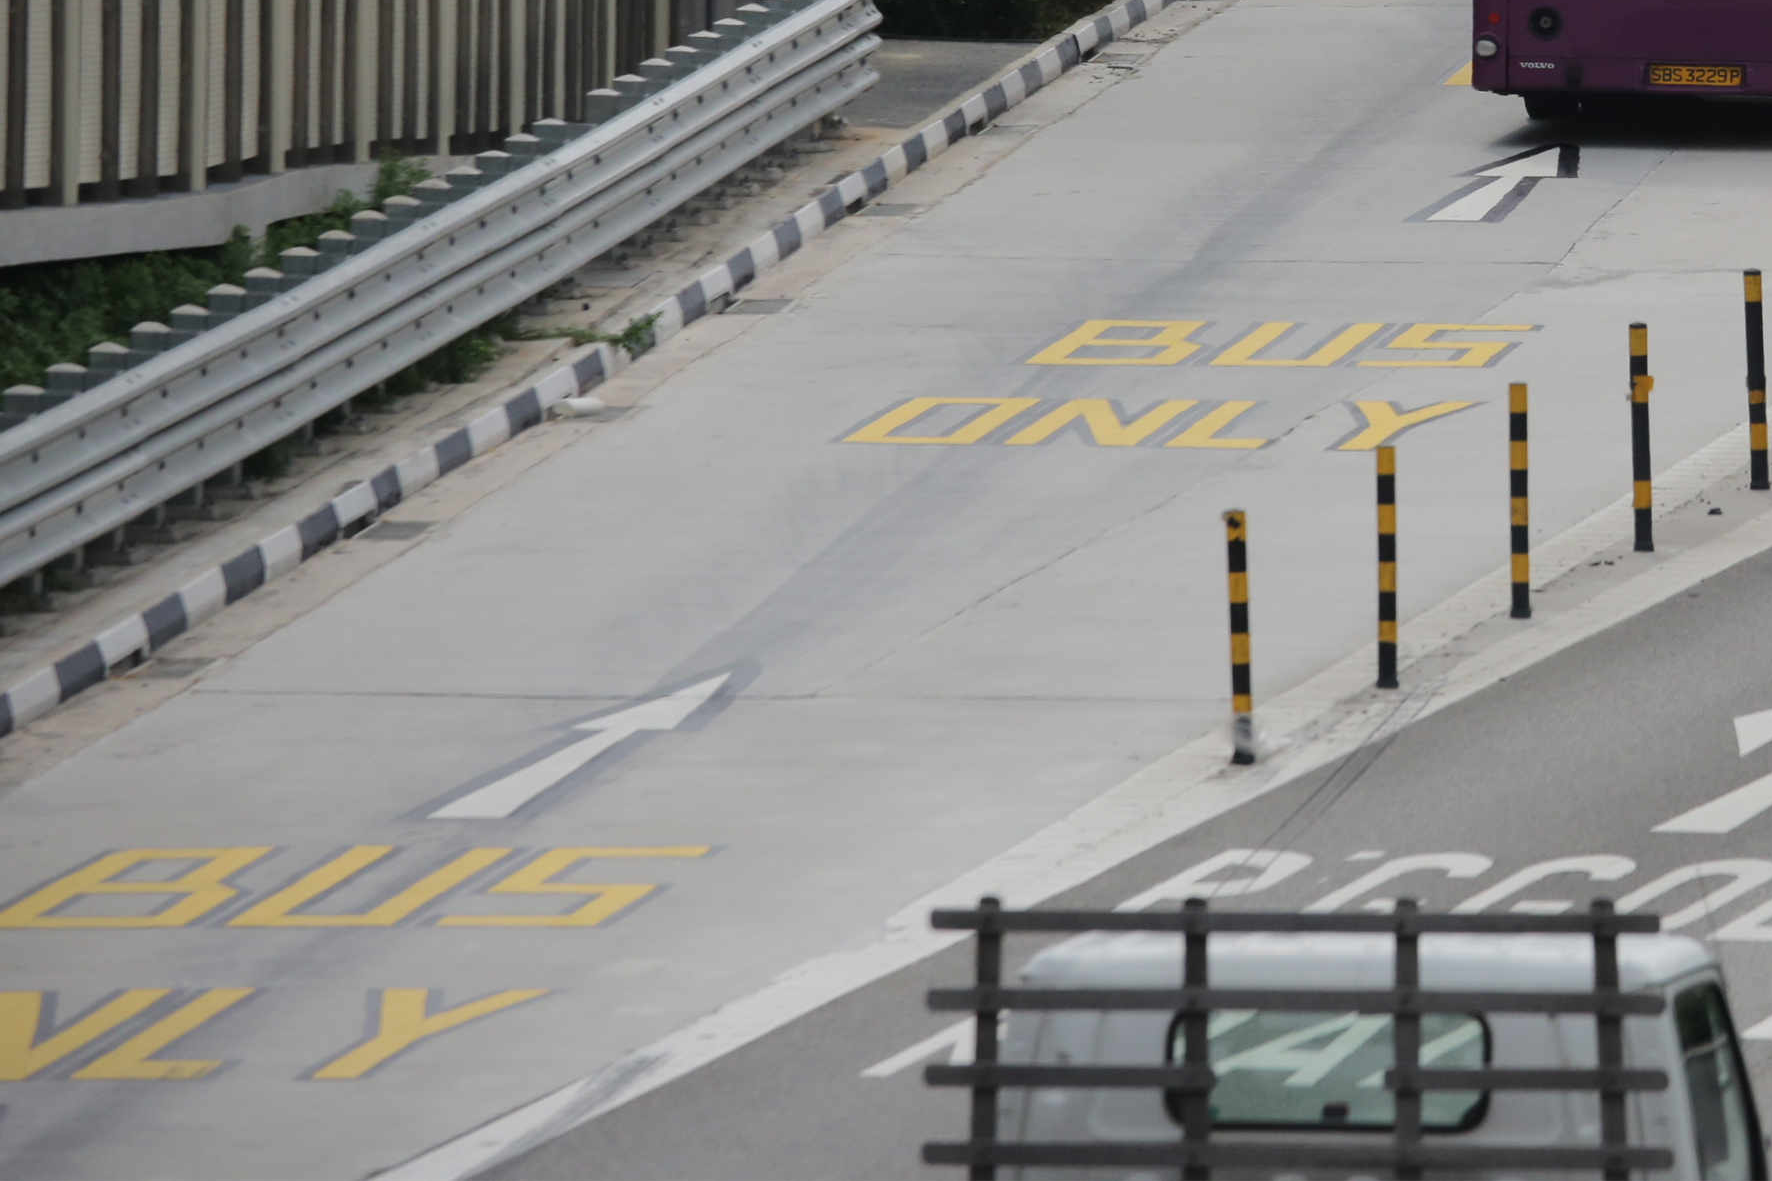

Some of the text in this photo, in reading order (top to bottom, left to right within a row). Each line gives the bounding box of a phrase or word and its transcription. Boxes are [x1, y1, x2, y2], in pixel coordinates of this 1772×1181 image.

[1519, 61, 1555, 70] VOLVO
[1024, 319, 1535, 366] BUS
[840, 397, 1484, 450] ONLY
[0, 845, 715, 928] BUS
